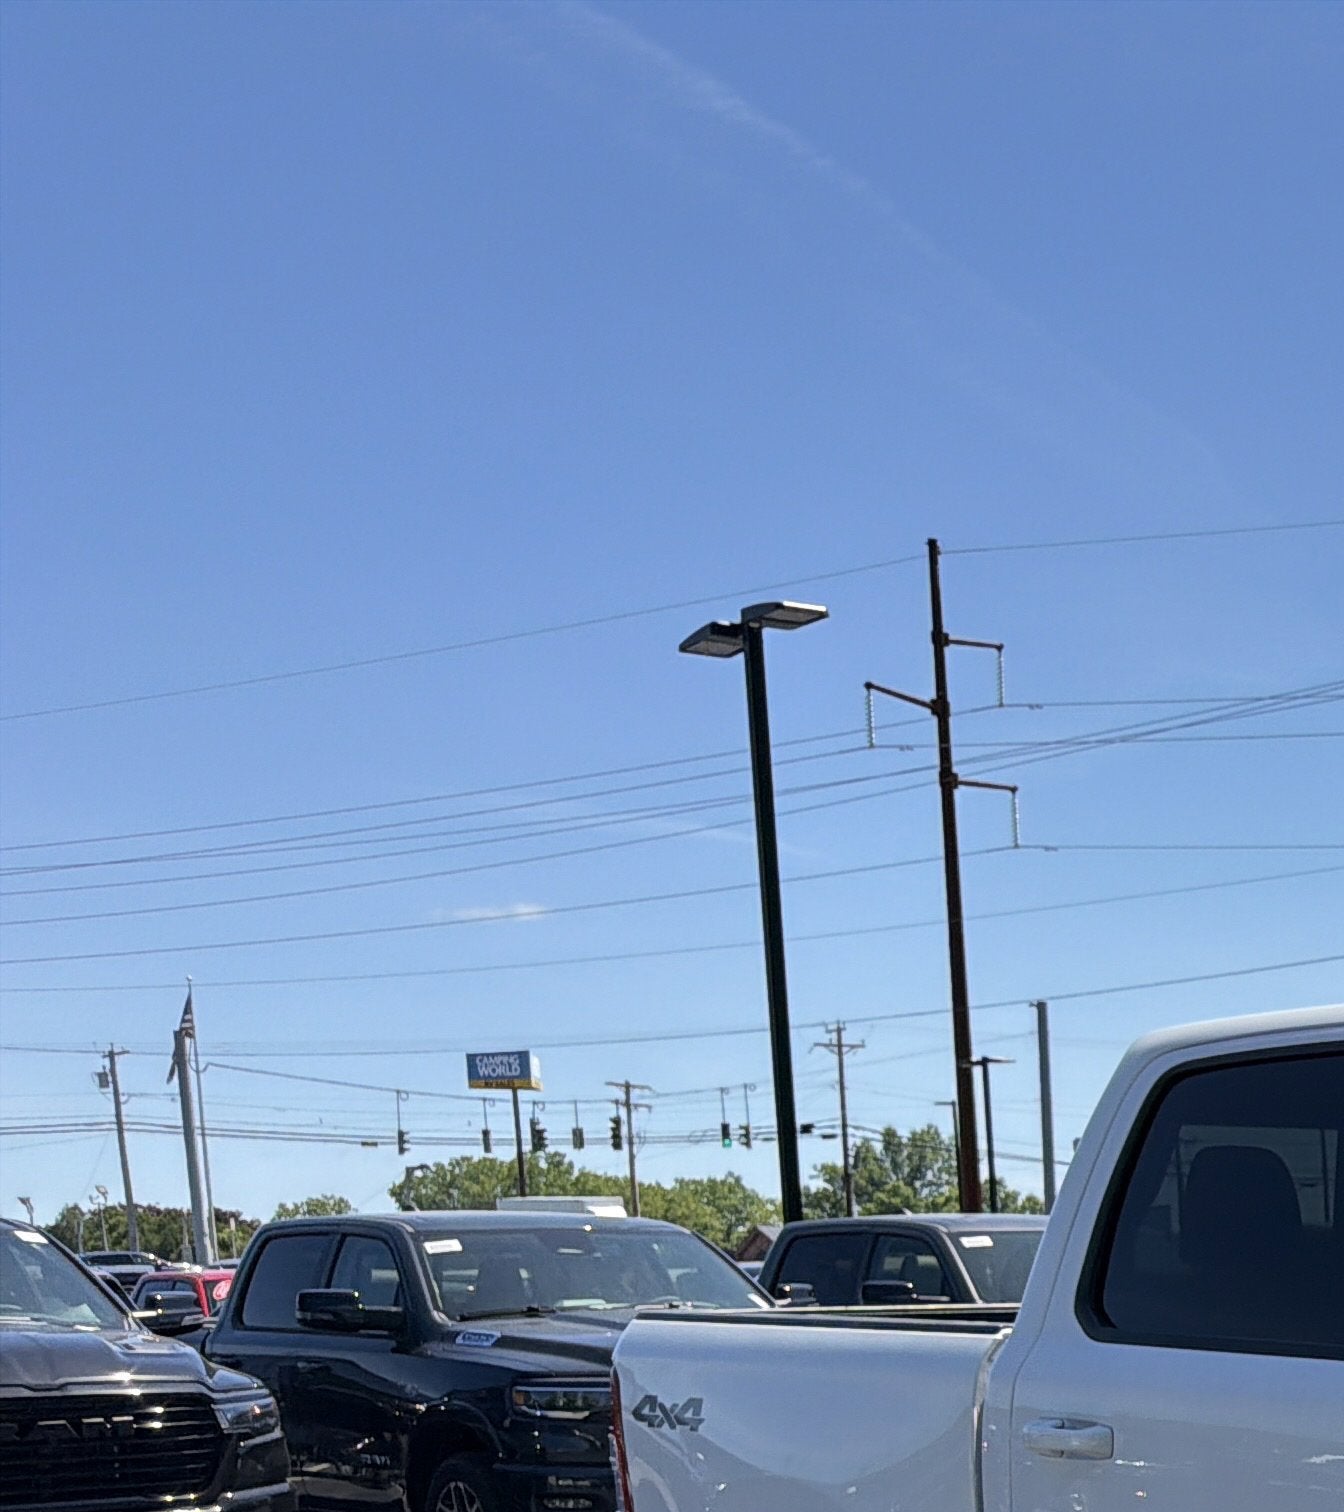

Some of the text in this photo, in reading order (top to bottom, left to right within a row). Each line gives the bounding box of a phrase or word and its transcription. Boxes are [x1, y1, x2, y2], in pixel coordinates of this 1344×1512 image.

[475, 1054, 519, 1066] CAMPING
[478, 1063, 521, 1078] WORLD
[632, 1394, 706, 1433] 4x4
